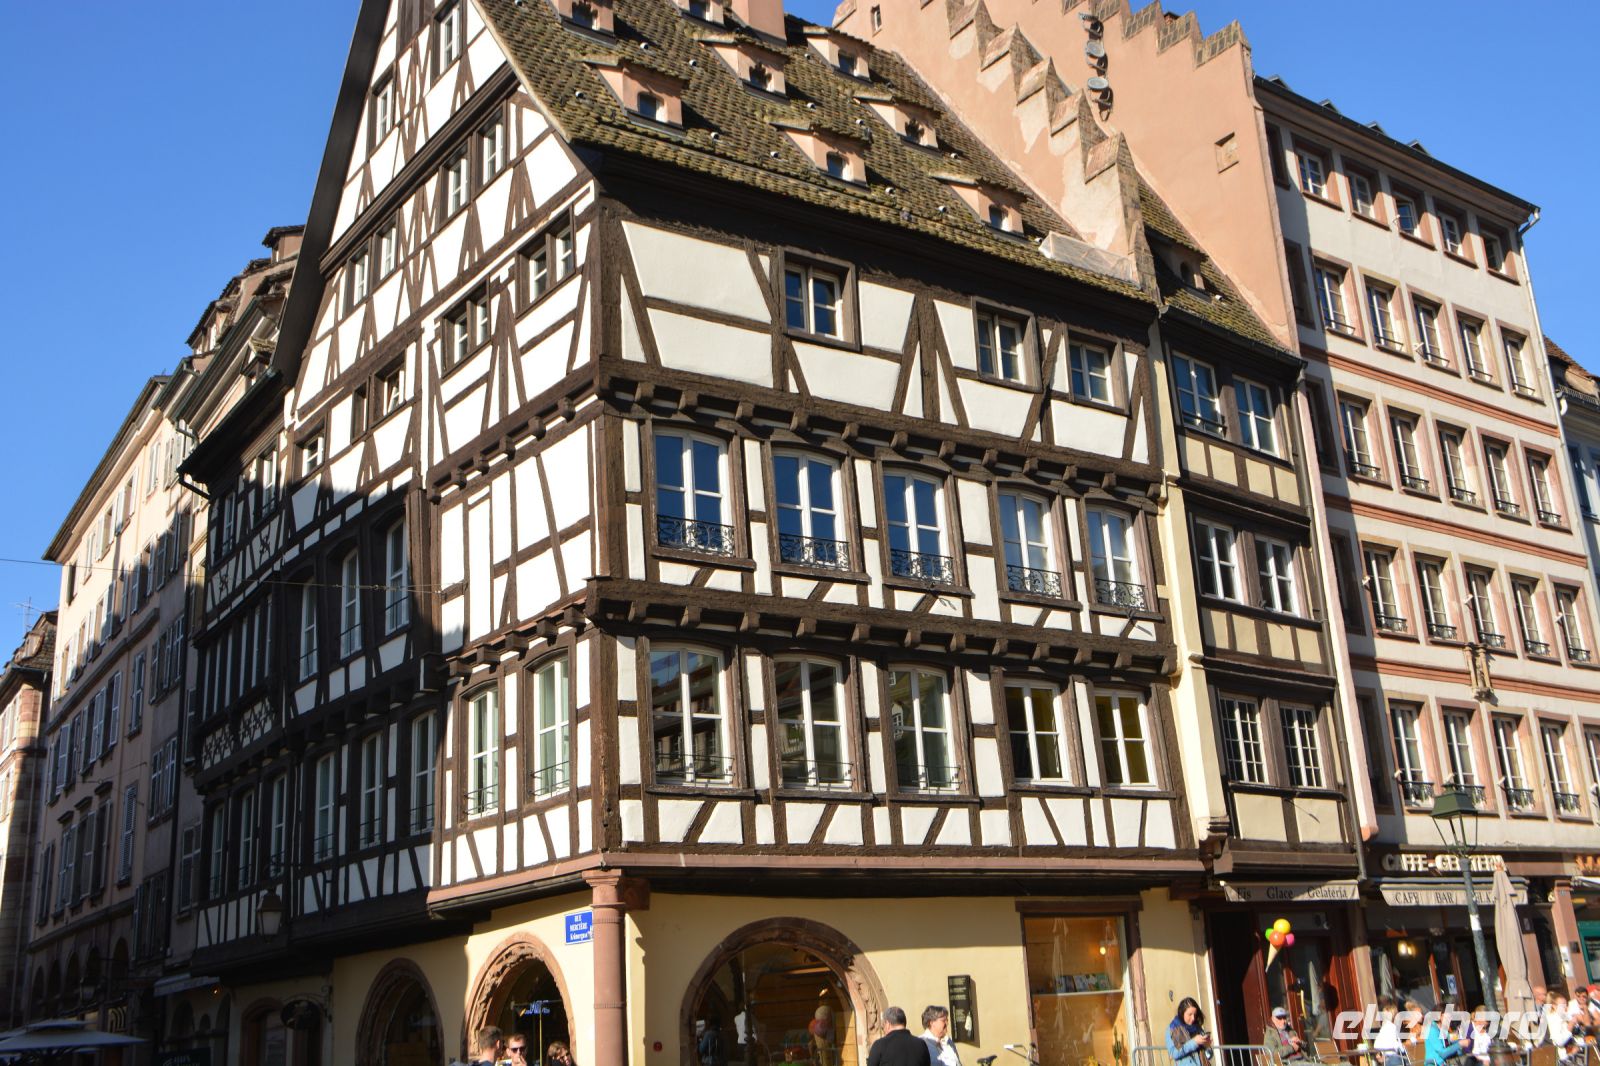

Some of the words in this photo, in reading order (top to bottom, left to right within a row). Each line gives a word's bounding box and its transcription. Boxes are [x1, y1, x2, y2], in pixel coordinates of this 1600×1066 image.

[1266, 887, 1294, 900] Glace
[1307, 885, 1347, 899] Gelateria
[1435, 891, 1455, 905] BAR
